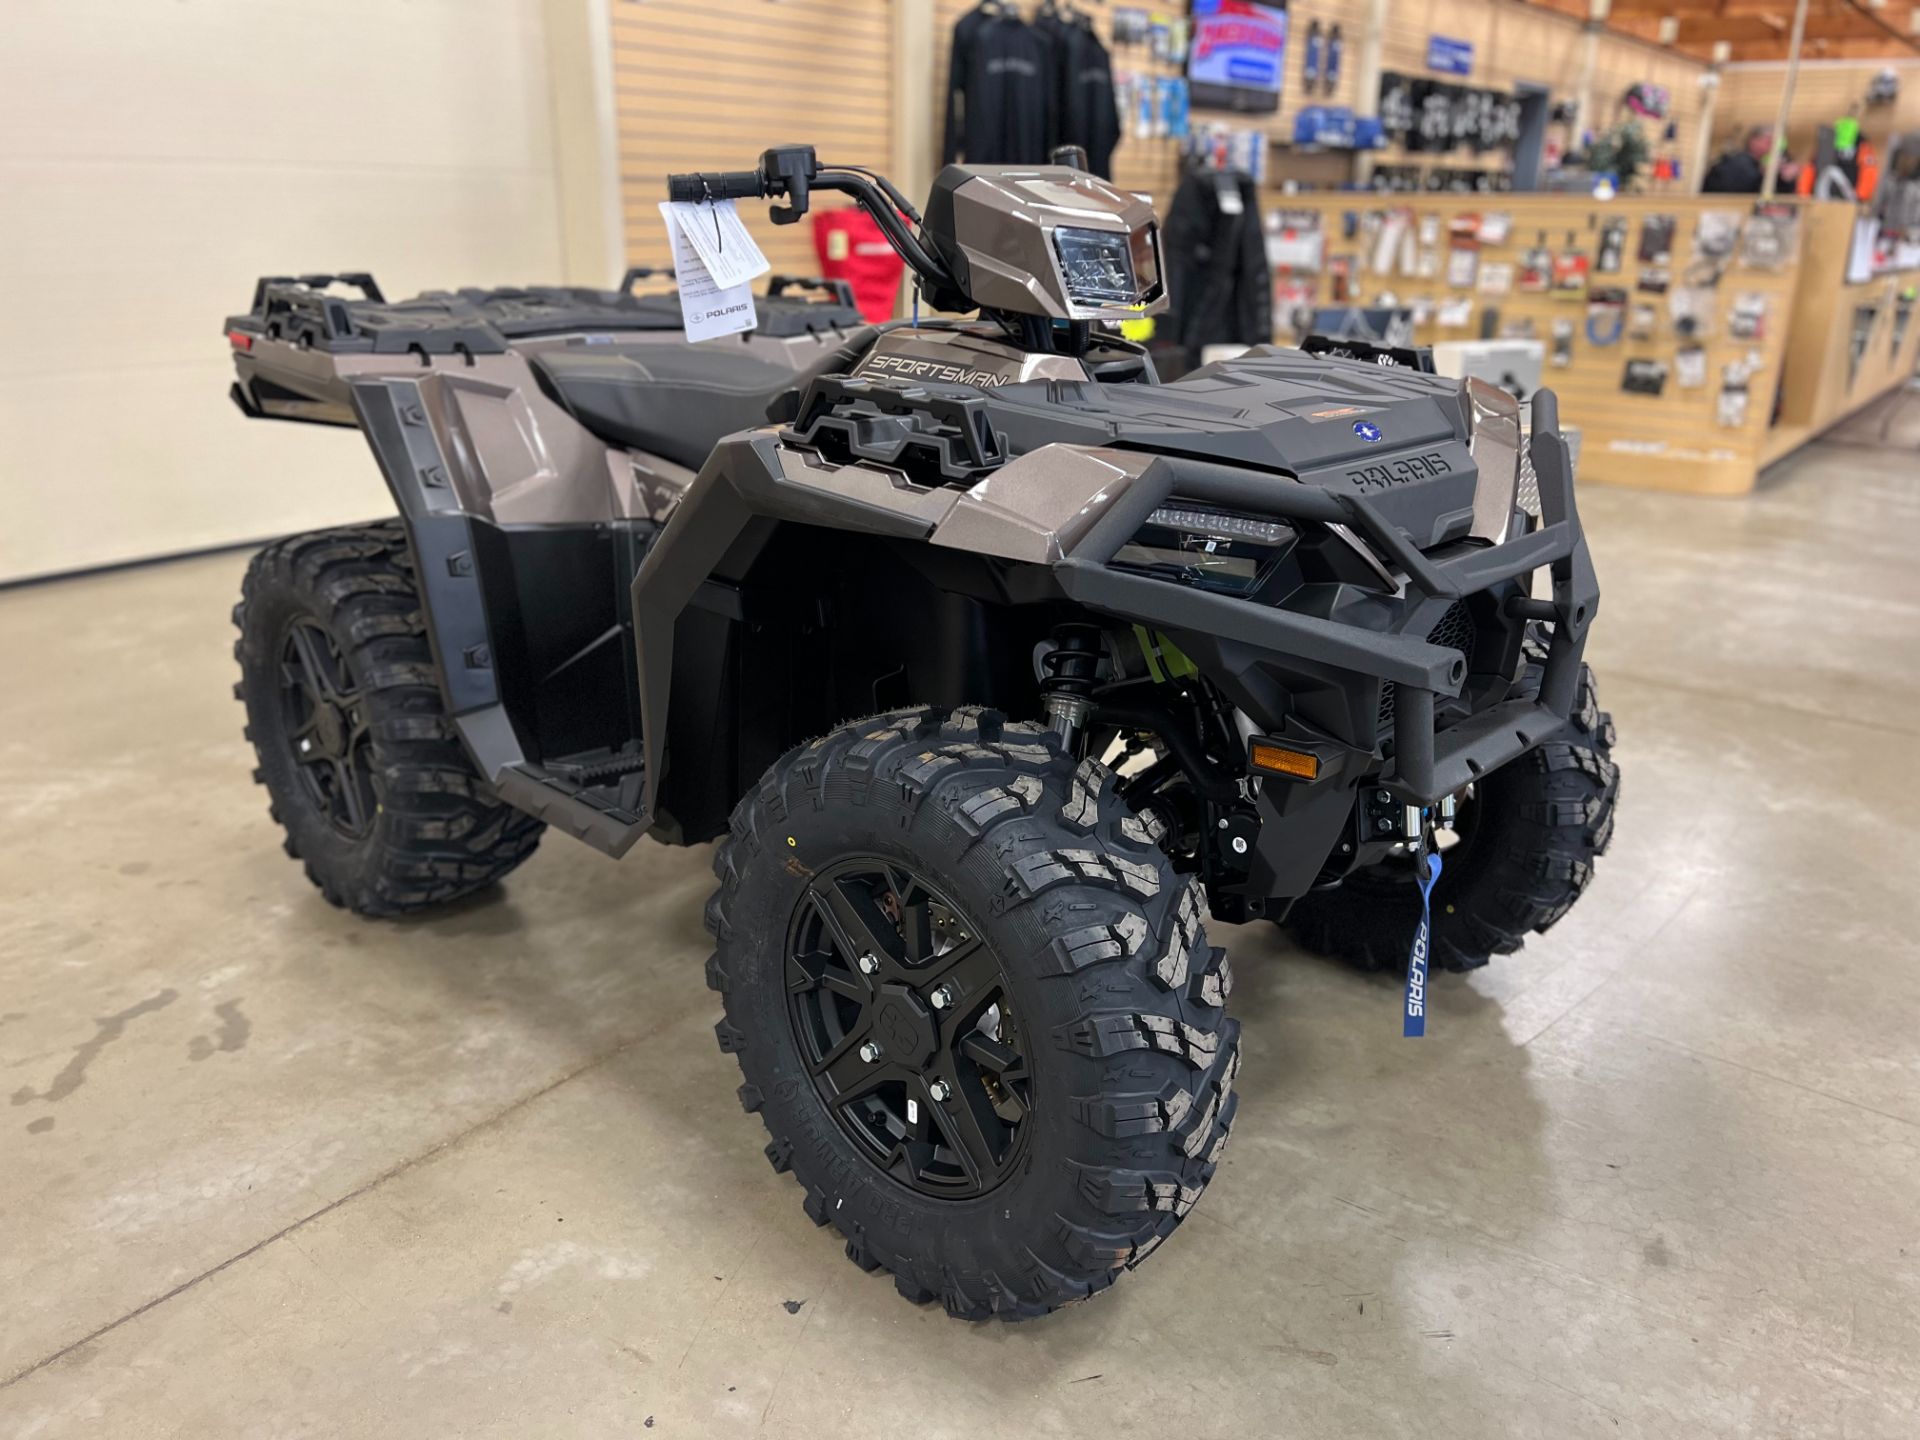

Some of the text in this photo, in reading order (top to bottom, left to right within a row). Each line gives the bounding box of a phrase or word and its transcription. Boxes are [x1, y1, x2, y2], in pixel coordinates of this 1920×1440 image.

[706, 304, 748, 319] POLARIS
[868, 355, 1010, 387] SPORTSMAN
[1346, 453, 1452, 493] POLARIS
[1408, 921, 1427, 1017] POLARIS
